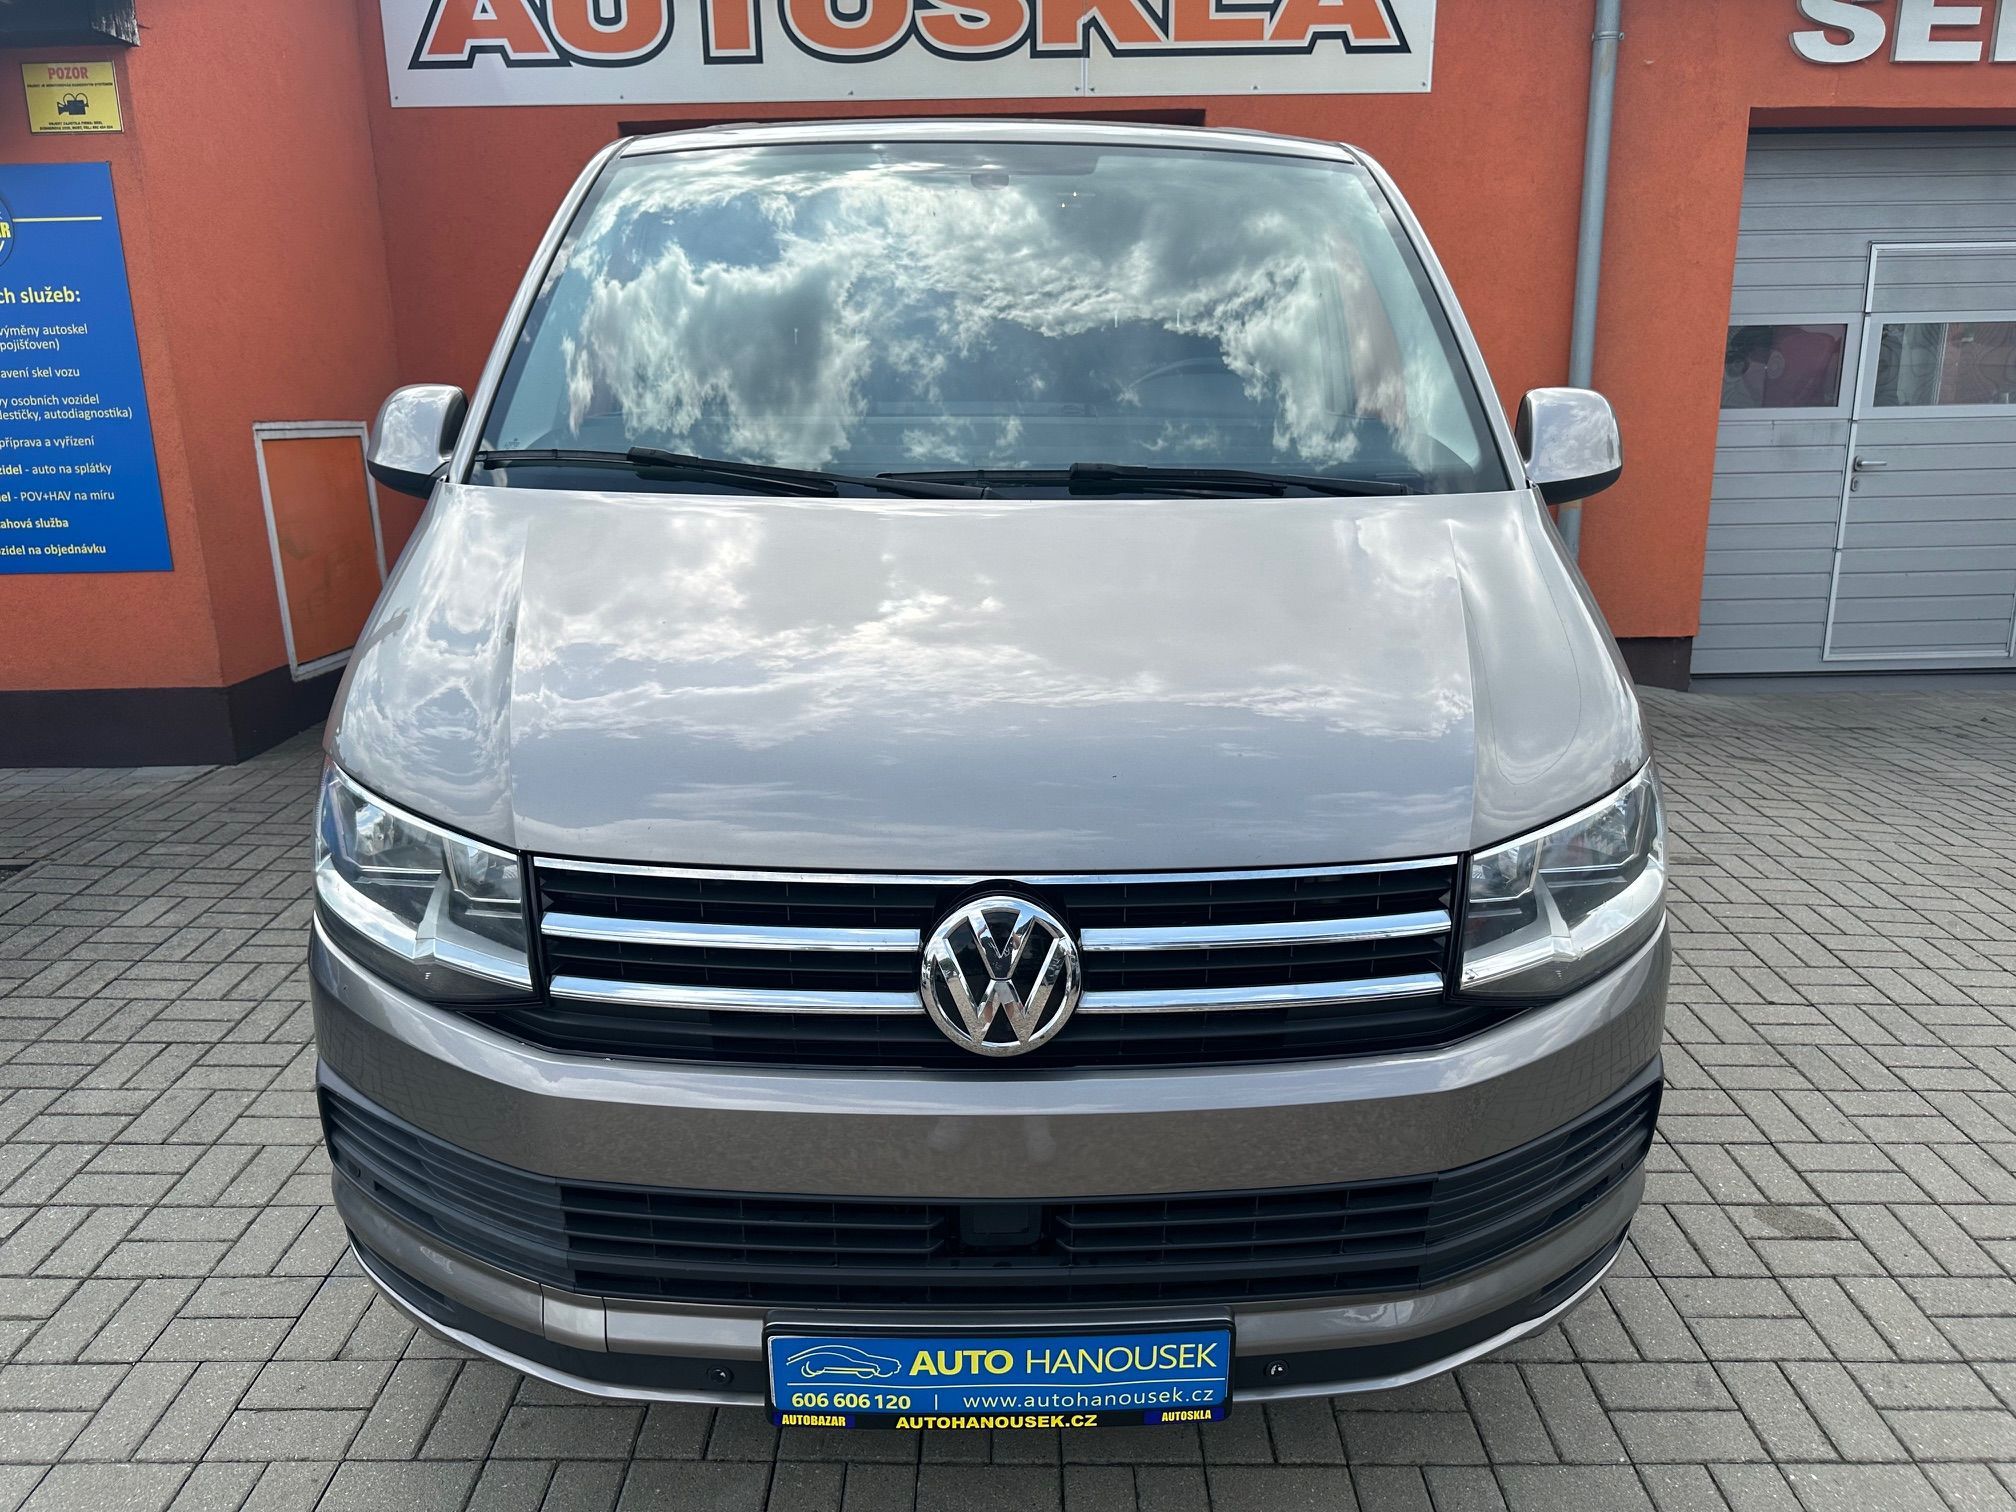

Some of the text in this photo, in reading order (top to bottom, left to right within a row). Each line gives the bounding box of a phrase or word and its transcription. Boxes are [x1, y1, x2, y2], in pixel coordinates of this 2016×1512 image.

[1789, 0, 2016, 64] SE
[48, 67, 89, 80] POZOR
[21, 286, 81, 303] služeb:
[43, 323, 88, 335] autoskel
[32, 366, 52, 378] skel
[55, 368, 80, 377] vozu
[11, 395, 59, 406] osobních
[62, 394, 100, 405] vozidel
[44, 407, 133, 420] autodiagnostika)
[54, 435, 95, 449] vyřízení
[32, 466, 56, 474] auto
[59, 466, 72, 474] na
[75, 463, 112, 475] splátky
[20, 491, 71, 501] POV+HAV
[90, 491, 115, 500] míru
[0, 518, 69, 529] ahová služba
[28, 547, 42, 555] na
[44, 543, 107, 556] objednávku
[909, 1343, 1218, 1376] AUTO HANOUSEK
[791, 1386, 1213, 1410] 606 606 120 www.autohanousek.cz
[782, 1414, 846, 1427] AUTOBAZAR
[896, 1414, 1098, 1429] AUTOHANOUSEK.CZ
[1161, 1409, 1212, 1422] AUTOSKLA
